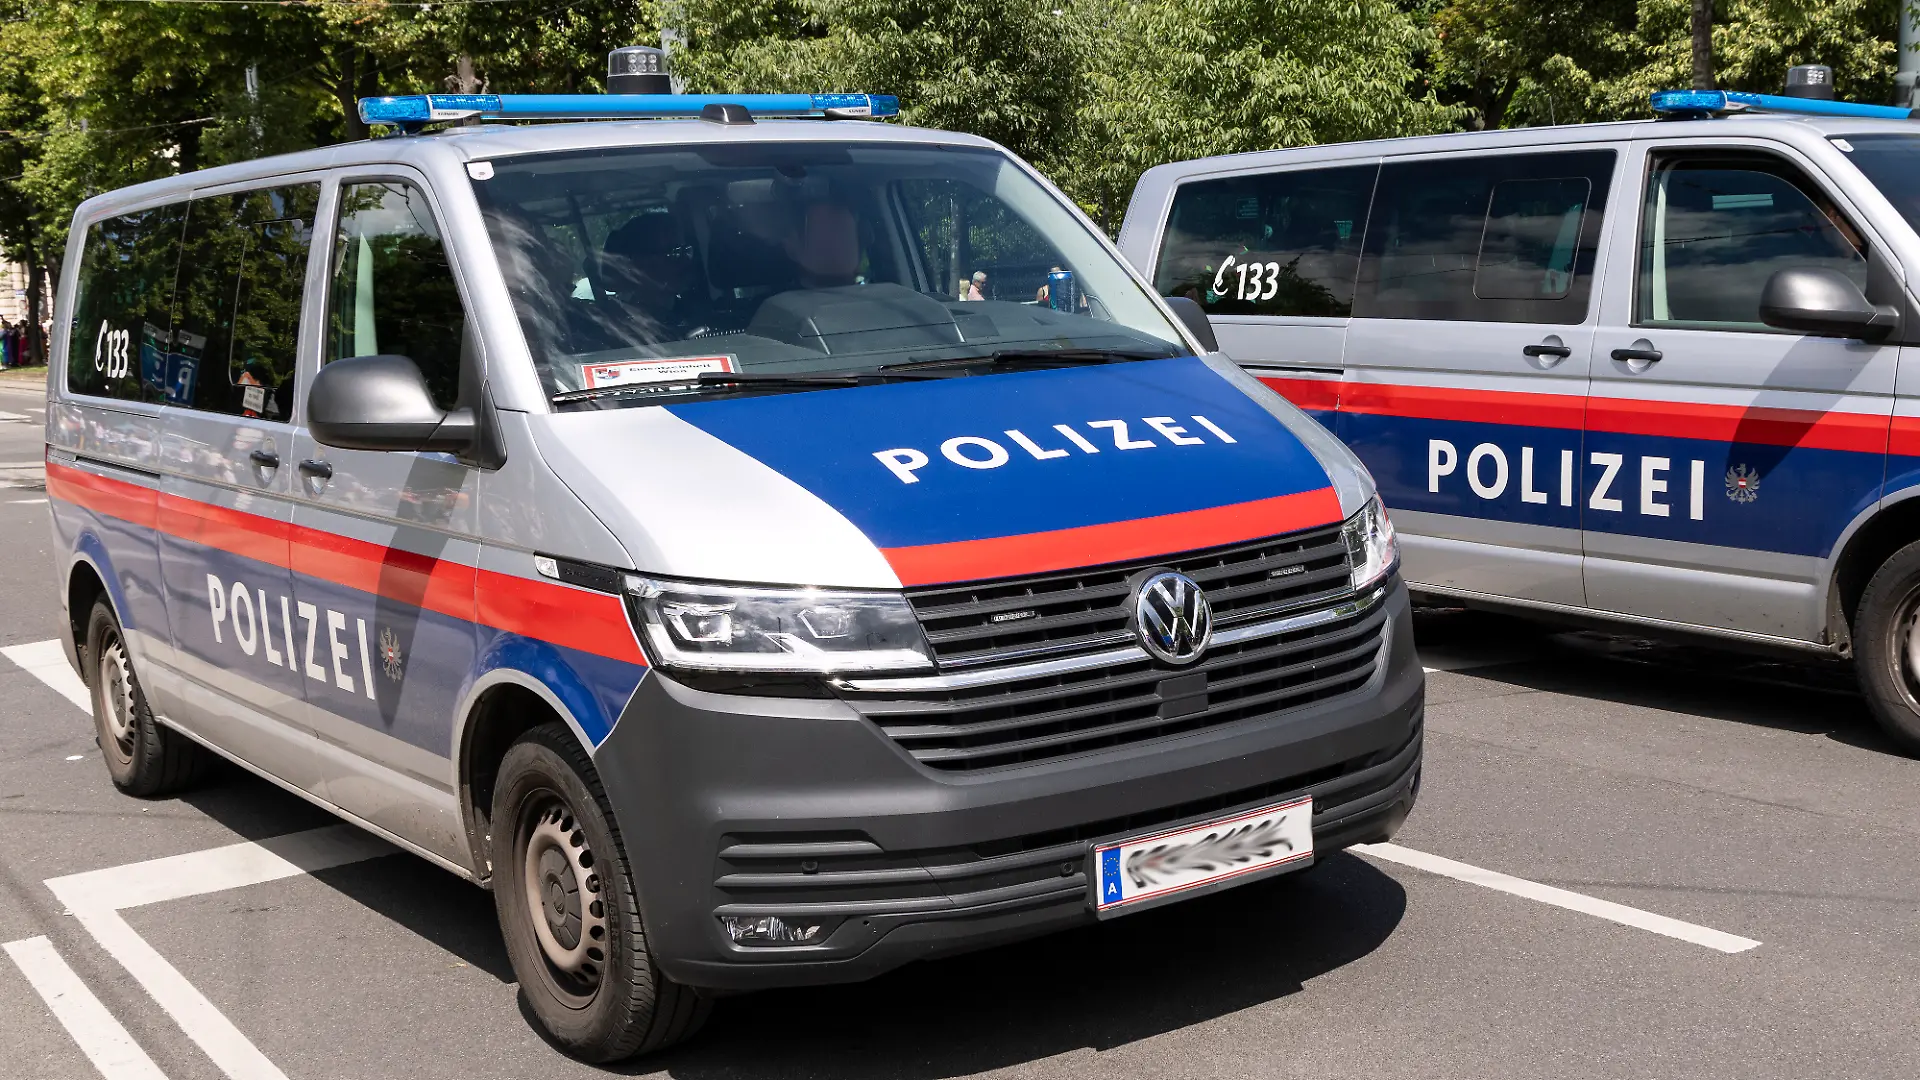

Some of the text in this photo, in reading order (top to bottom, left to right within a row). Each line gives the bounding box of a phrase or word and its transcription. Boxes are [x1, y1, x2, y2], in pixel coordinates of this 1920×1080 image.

[1236, 261, 1280, 301] 133
[106, 329, 130, 379] 133
[872, 415, 1238, 485] POLIZEI
[1428, 439, 1705, 521] POLIZEI
[206, 573, 376, 700] POLIZEI
[1107, 882, 1118, 896] A
